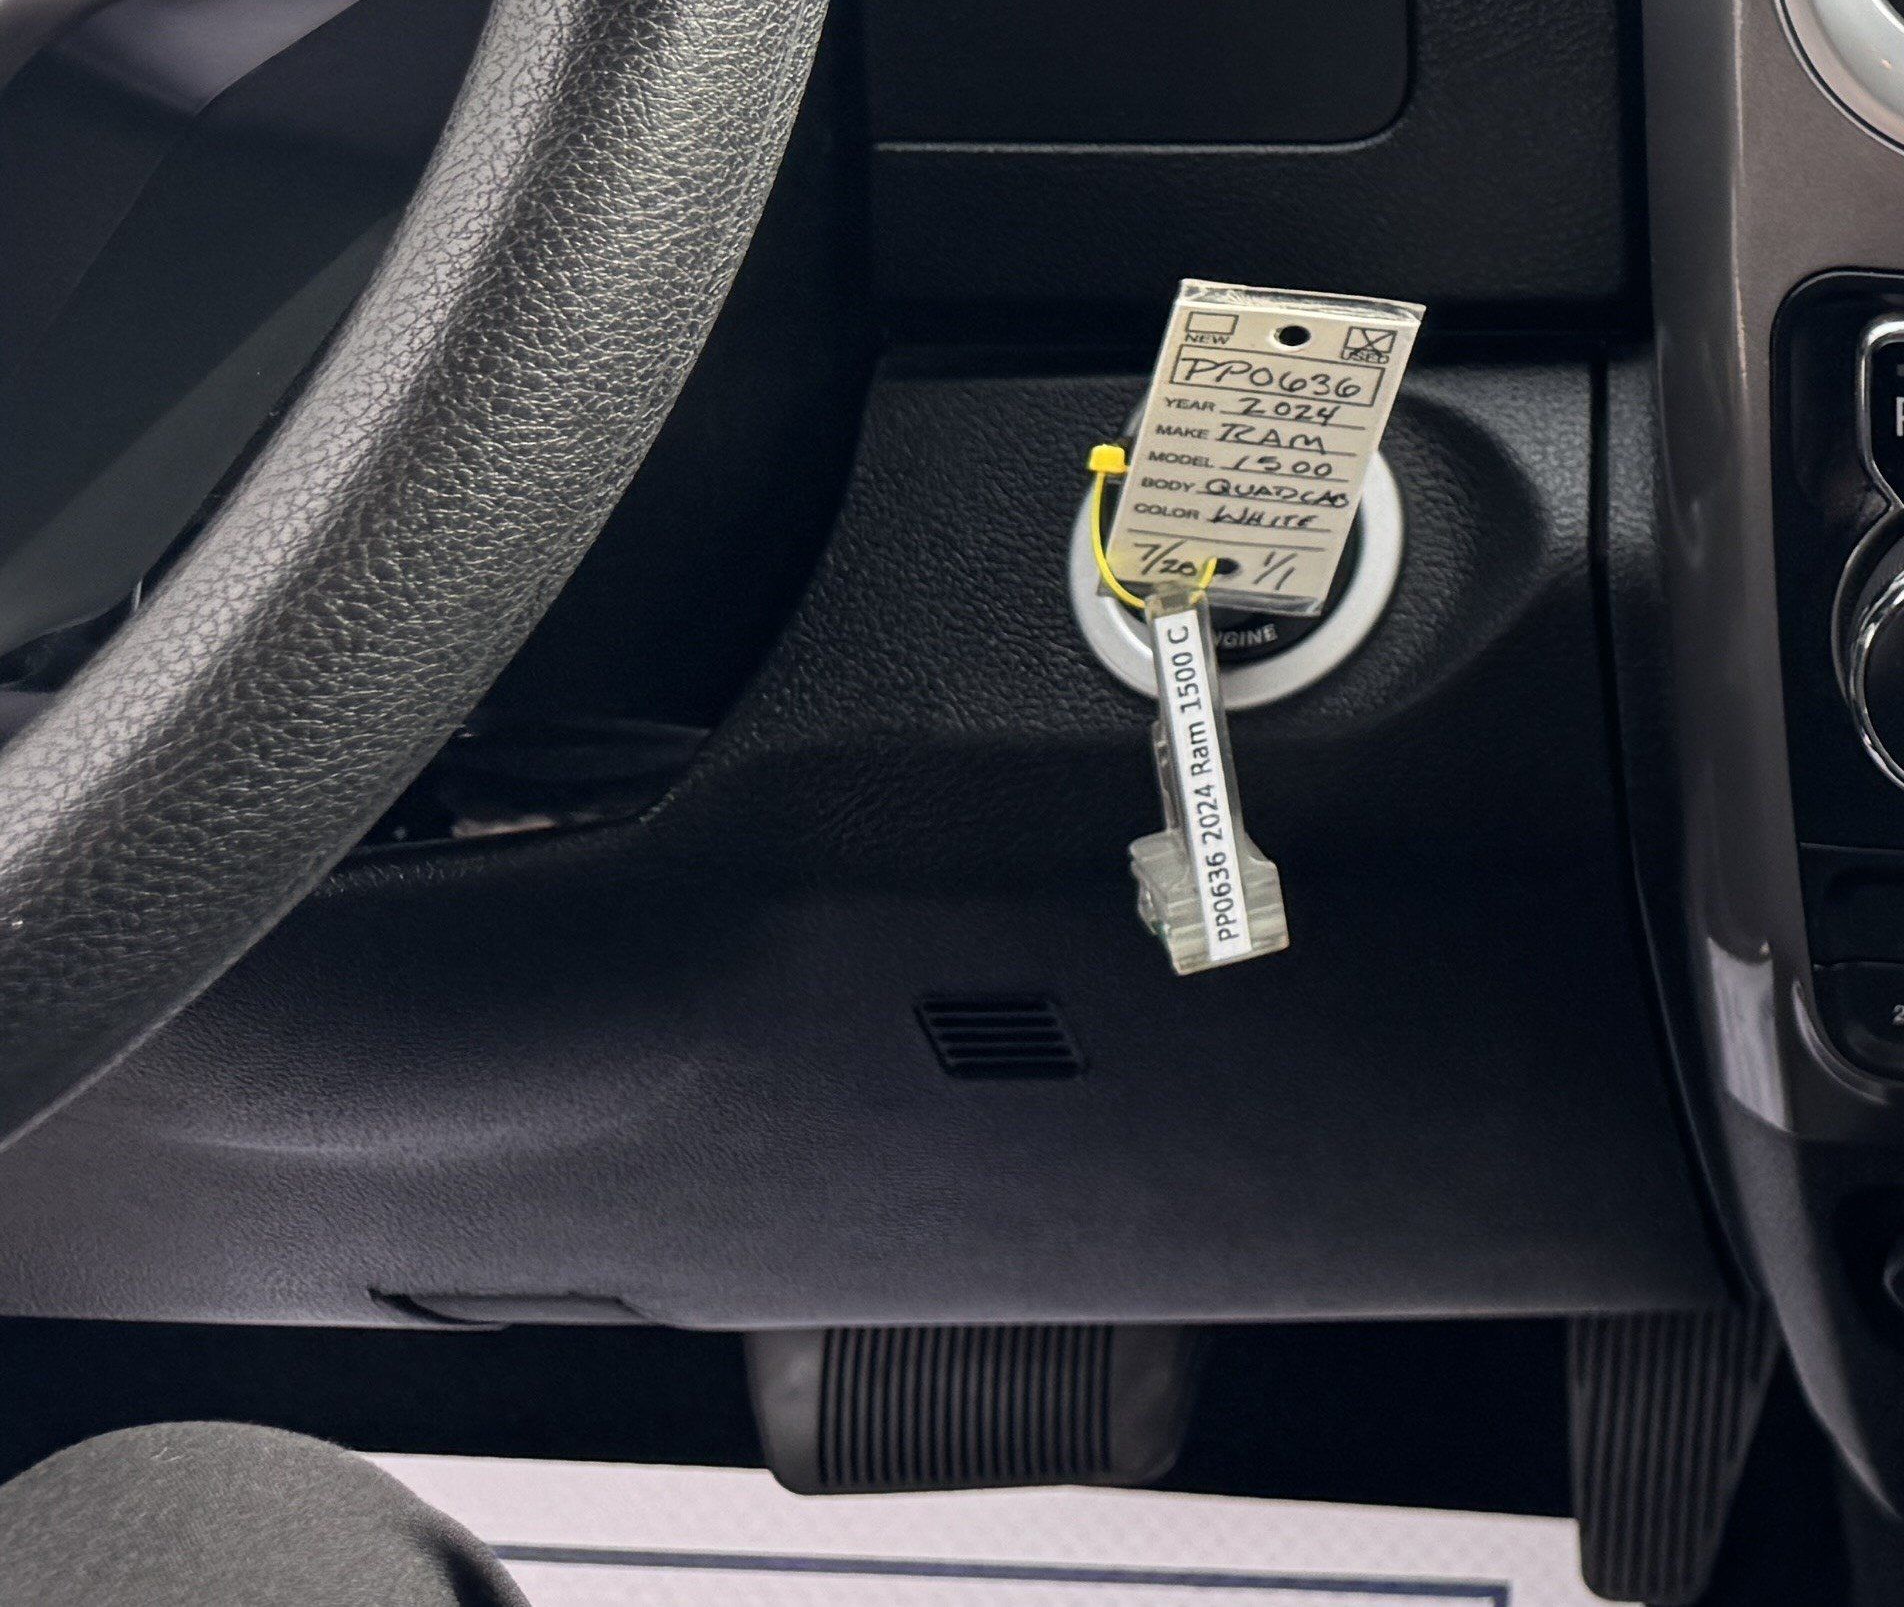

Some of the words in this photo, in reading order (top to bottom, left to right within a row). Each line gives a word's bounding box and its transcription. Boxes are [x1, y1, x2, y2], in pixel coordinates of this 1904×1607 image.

[1185, 334, 1230, 345] NEW
[1180, 357, 1362, 398] PP0636
[1164, 397, 1215, 413] YEAR
[1239, 397, 1341, 426] 2024
[1155, 424, 1208, 439] MAKE
[1217, 422, 1325, 455] RAM
[1149, 450, 1214, 468] MODEL
[1236, 456, 1332, 477] 1500
[1141, 476, 1195, 492] BODY
[1134, 502, 1200, 520] COLOR
[1206, 505, 1319, 528] WHITE
[1167, 625, 1189, 645] C
[1172, 650, 1203, 714] 1500
[1191, 721, 1213, 777] Ram
[1196, 784, 1223, 846] 2024
[1209, 852, 1238, 943] PP0636
